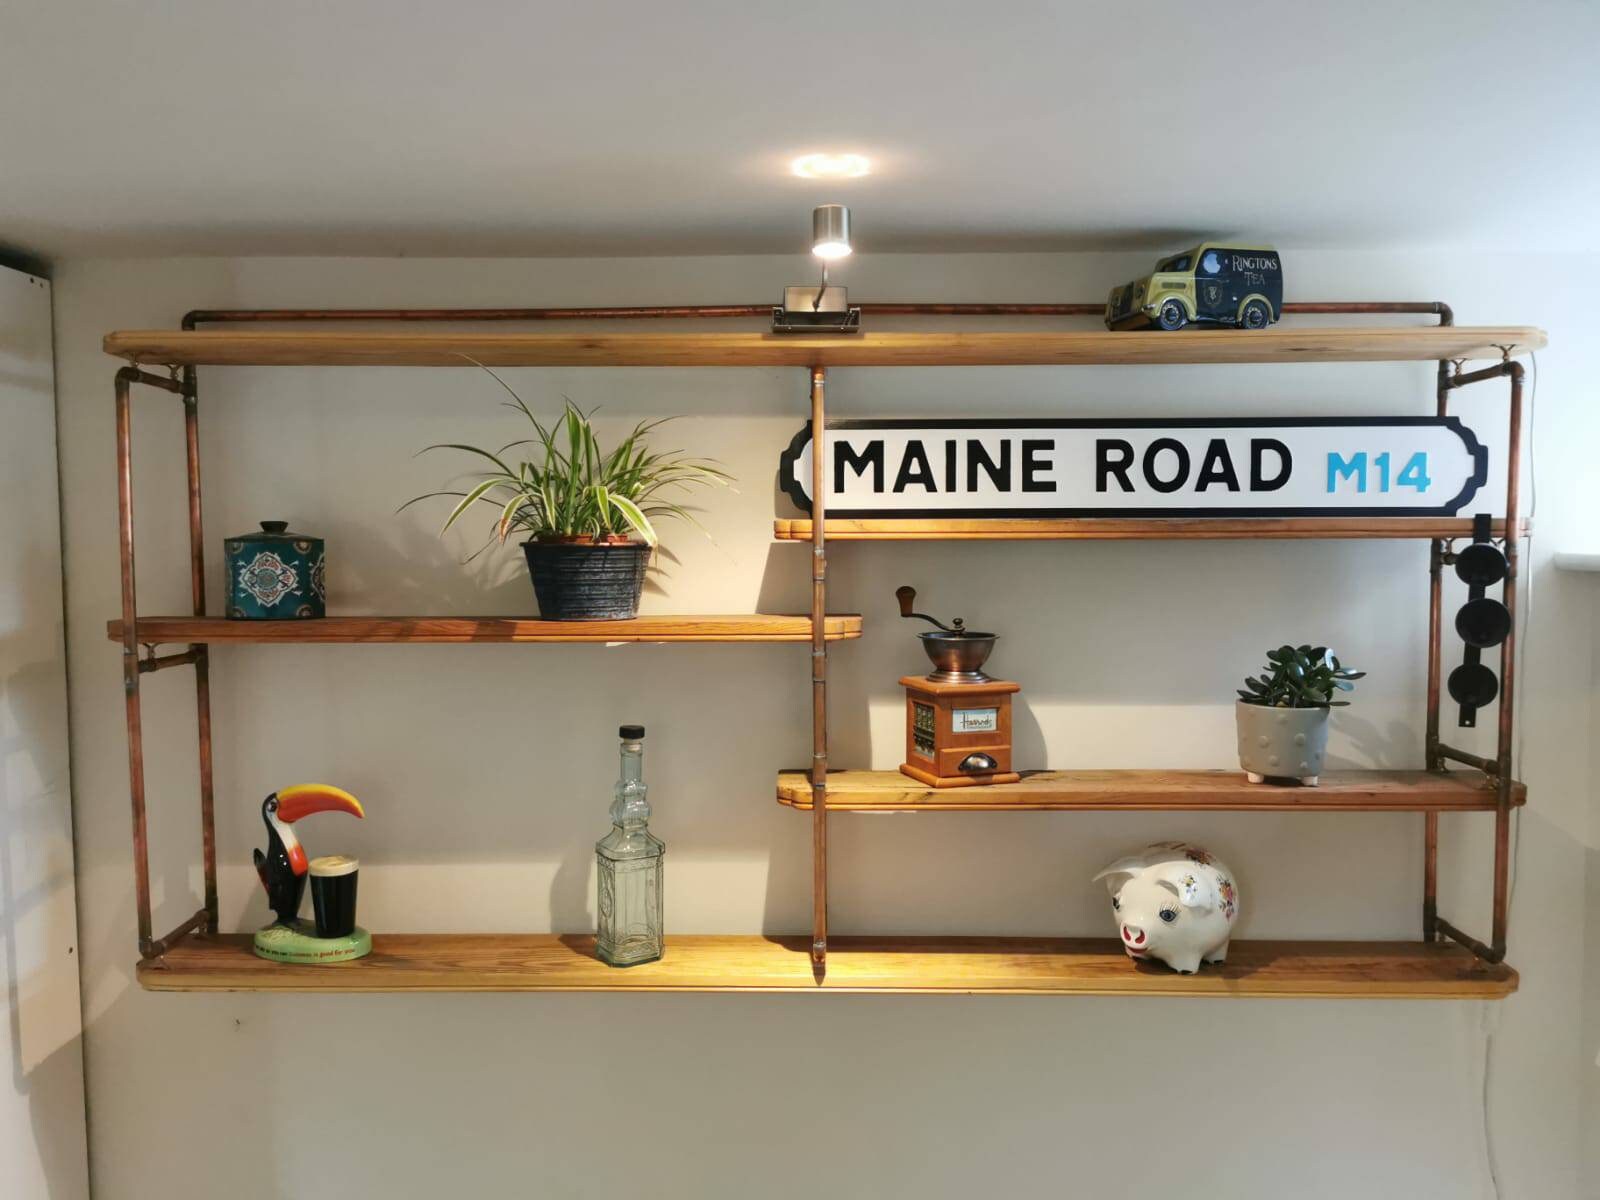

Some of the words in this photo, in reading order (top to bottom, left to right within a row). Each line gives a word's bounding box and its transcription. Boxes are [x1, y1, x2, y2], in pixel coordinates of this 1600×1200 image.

[1232, 255, 1278, 271] RINGTONS
[1244, 272, 1265, 286] TEA
[834, 439, 1057, 493] MAINE
[1096, 438, 1293, 493] ROAD
[1327, 452, 1431, 493] M14
